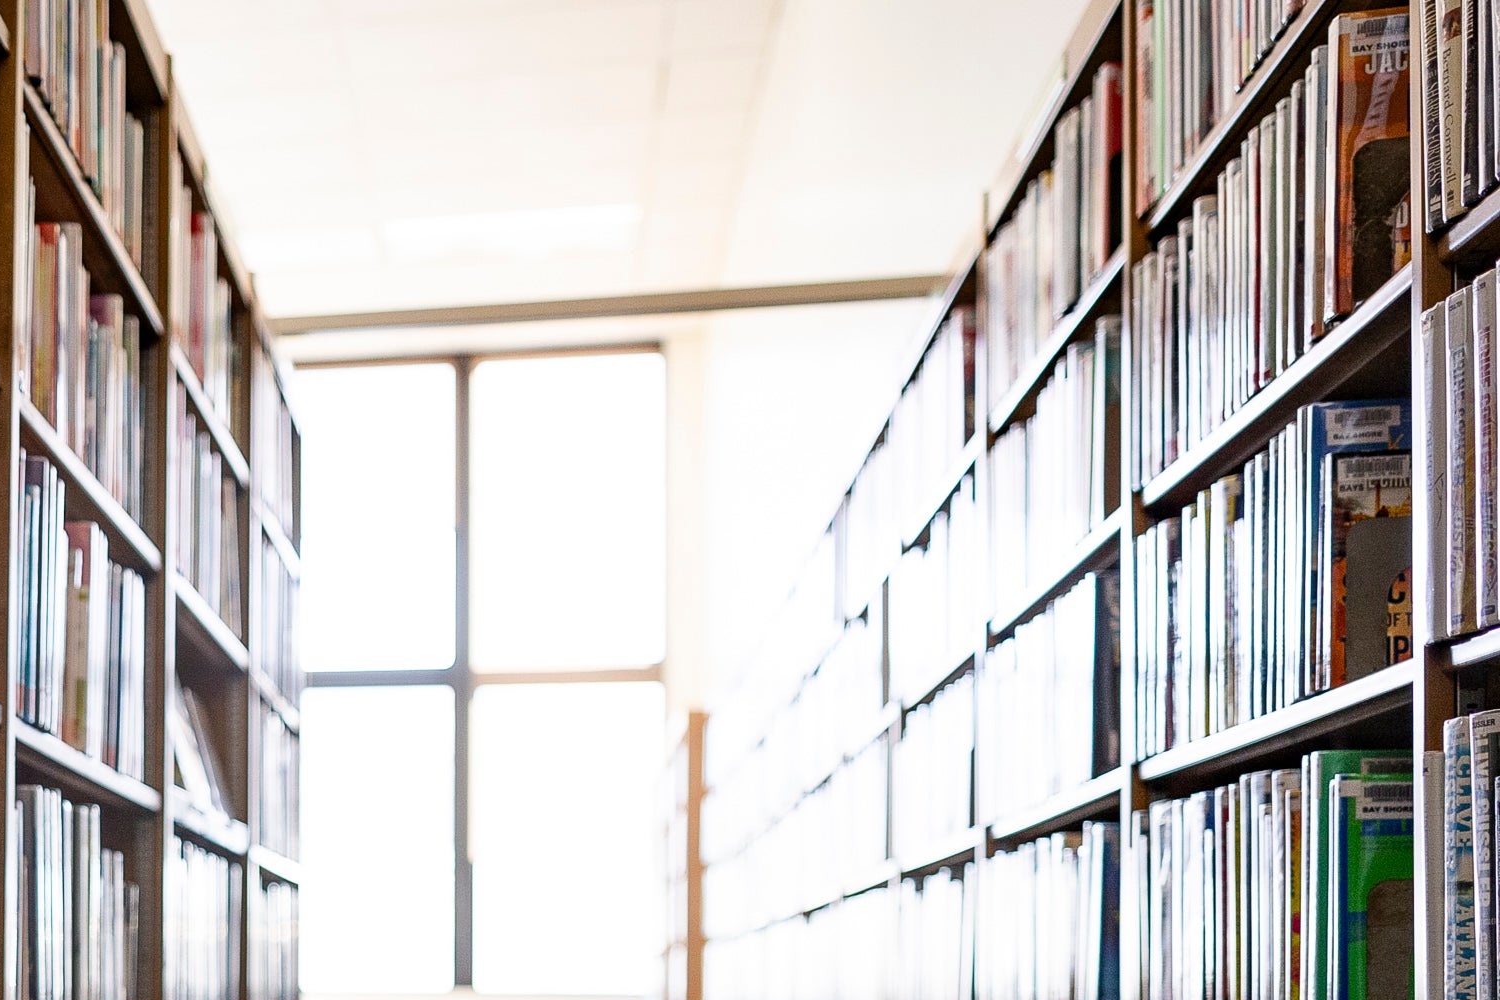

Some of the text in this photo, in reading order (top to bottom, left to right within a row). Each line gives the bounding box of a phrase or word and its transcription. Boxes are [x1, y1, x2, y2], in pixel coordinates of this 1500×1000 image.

[1442, 48, 1457, 184] Bernard Cornwell
[1428, 134, 1442, 187] FORTRESS
[1479, 327, 1491, 386] ERINE
[1481, 491, 1494, 572] NEMESIS
[1455, 755, 1472, 848] CLIVE
[1476, 798, 1491, 907] CUSSLER
